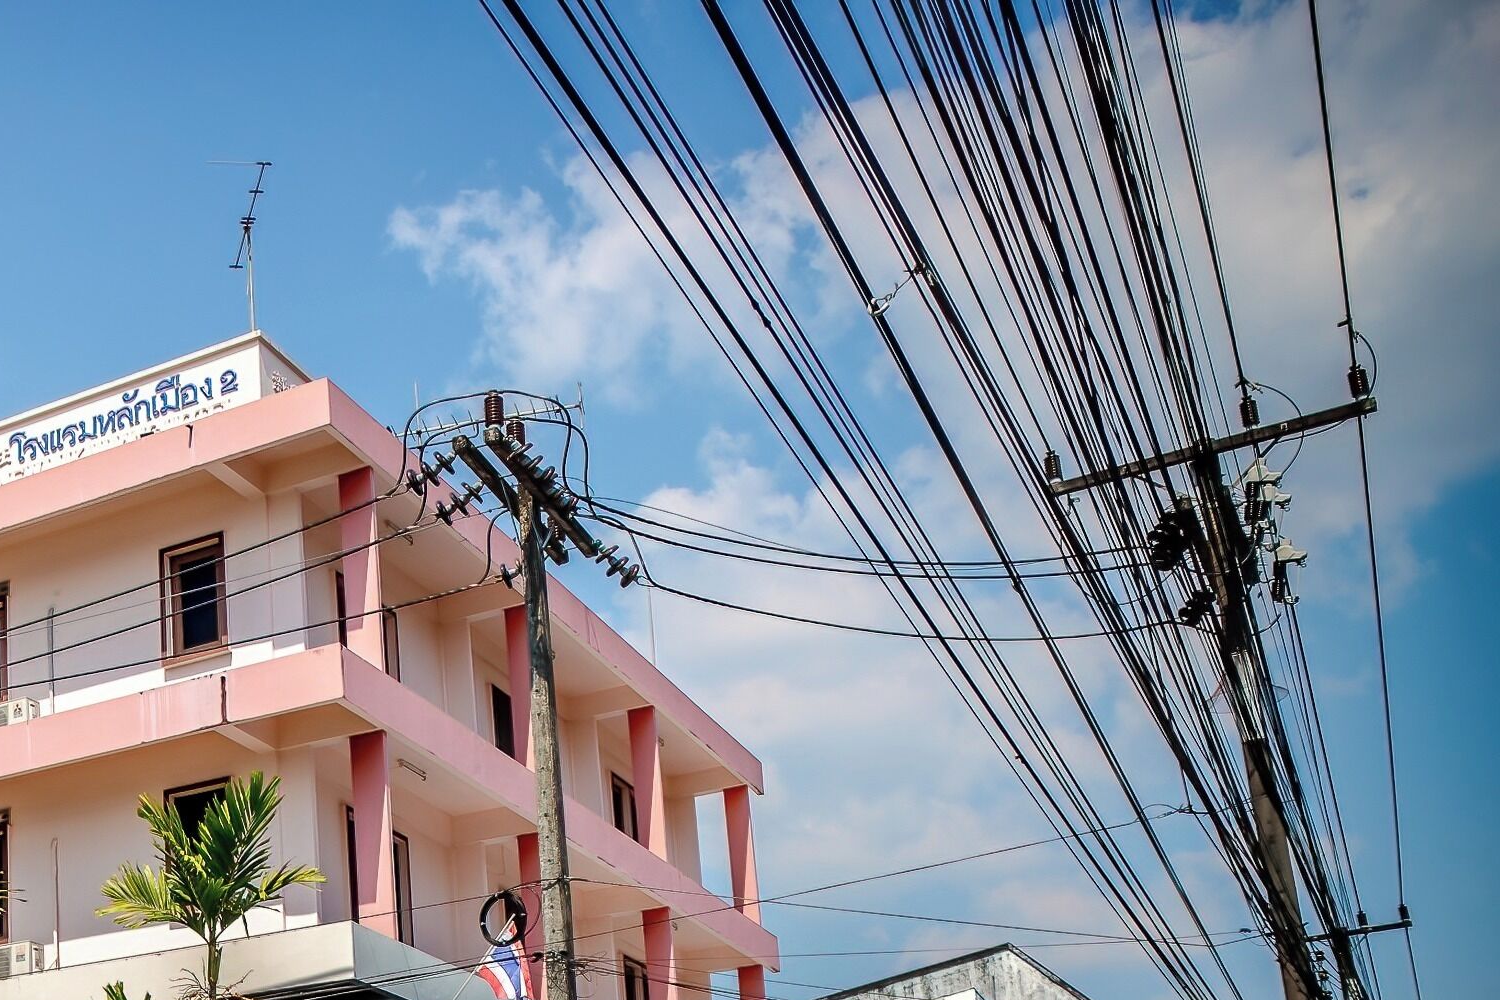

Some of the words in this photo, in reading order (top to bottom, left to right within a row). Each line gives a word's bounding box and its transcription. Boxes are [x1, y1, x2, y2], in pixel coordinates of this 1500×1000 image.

[9, 373, 213, 464] โรงแรมหลักเมือง
[220, 369, 238, 396] 2
